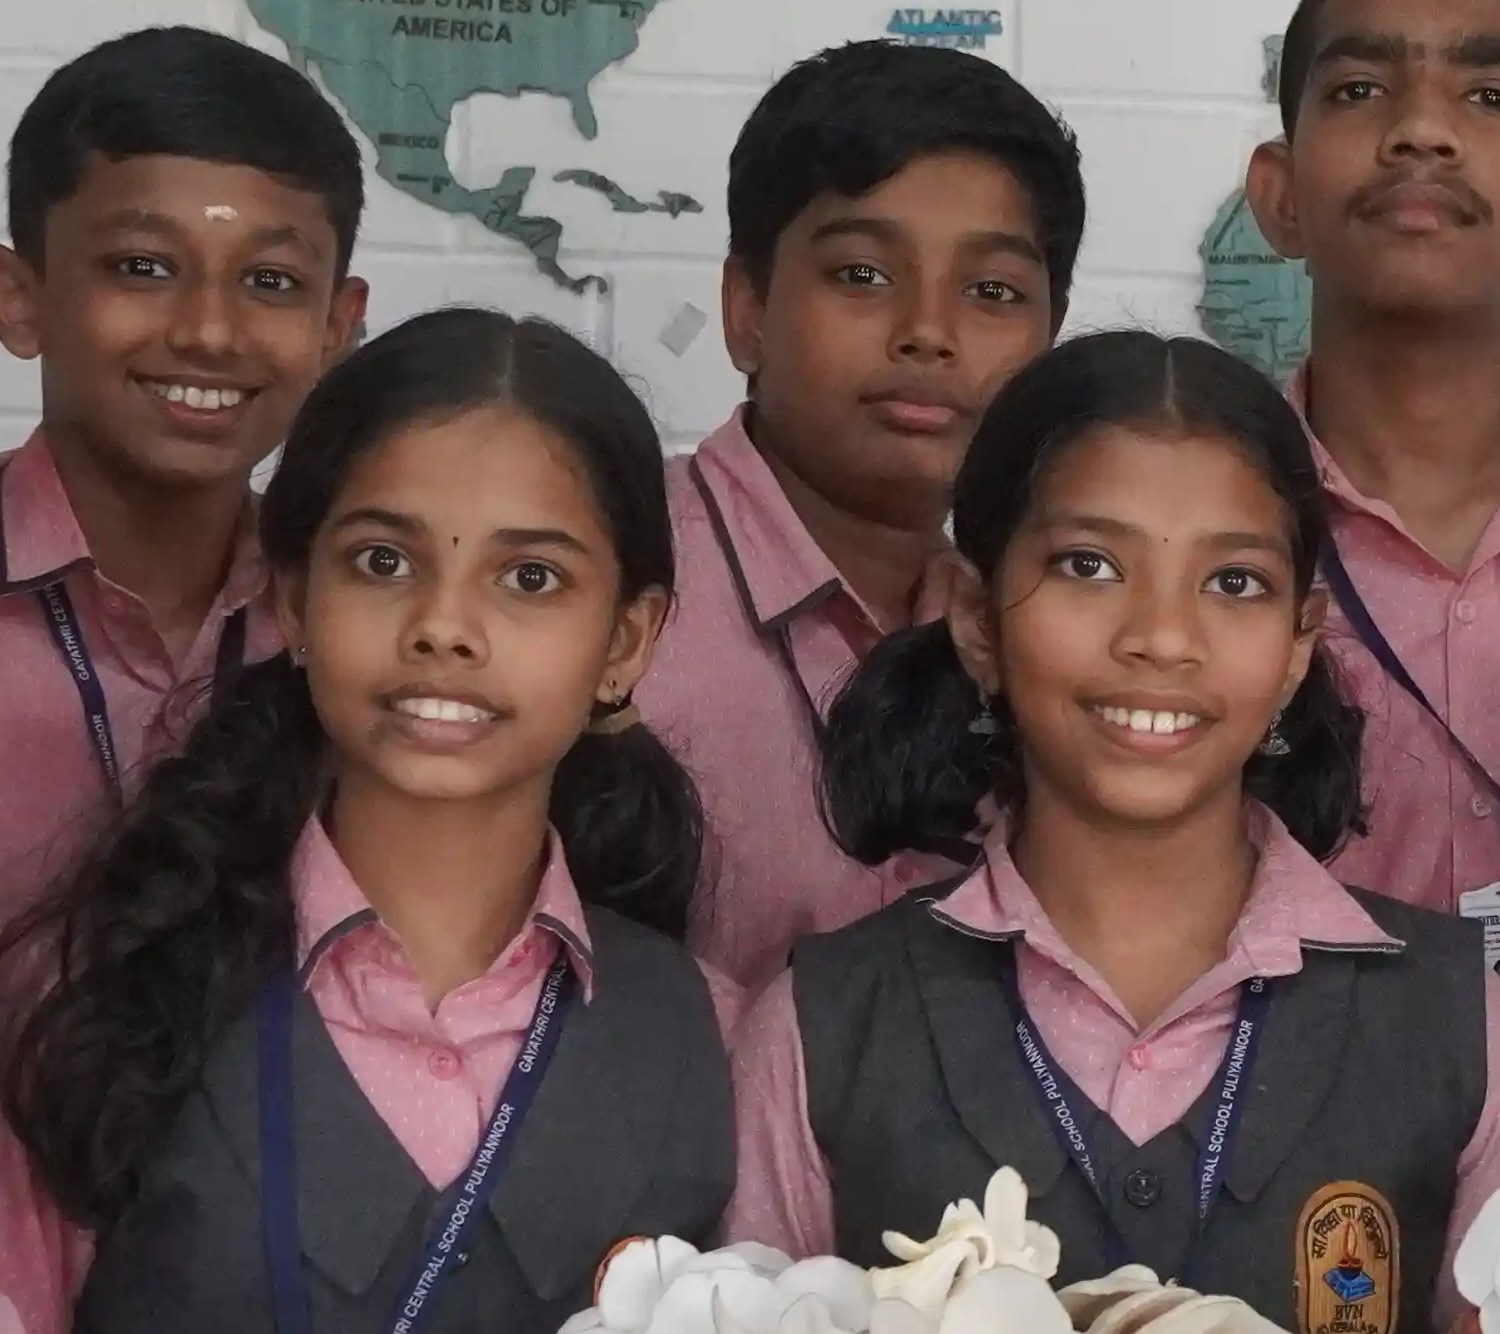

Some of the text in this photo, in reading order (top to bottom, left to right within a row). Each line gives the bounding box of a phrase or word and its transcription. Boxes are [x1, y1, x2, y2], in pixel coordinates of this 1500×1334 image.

[392, 15, 513, 45] AMERICA
[518, 968, 568, 1073] GAYATHRI CENTRAL
[1015, 1019, 1086, 1153] SCHOOL PULIYANNOOR
[1208, 1102, 1234, 1153] SCHOOL
[1221, 1018, 1254, 1100] PULIYANNOOR
[404, 1254, 447, 1318] CENTRAL
[438, 1191, 475, 1253] SCHOOL
[464, 1103, 516, 1197] PULIYANNOOR
